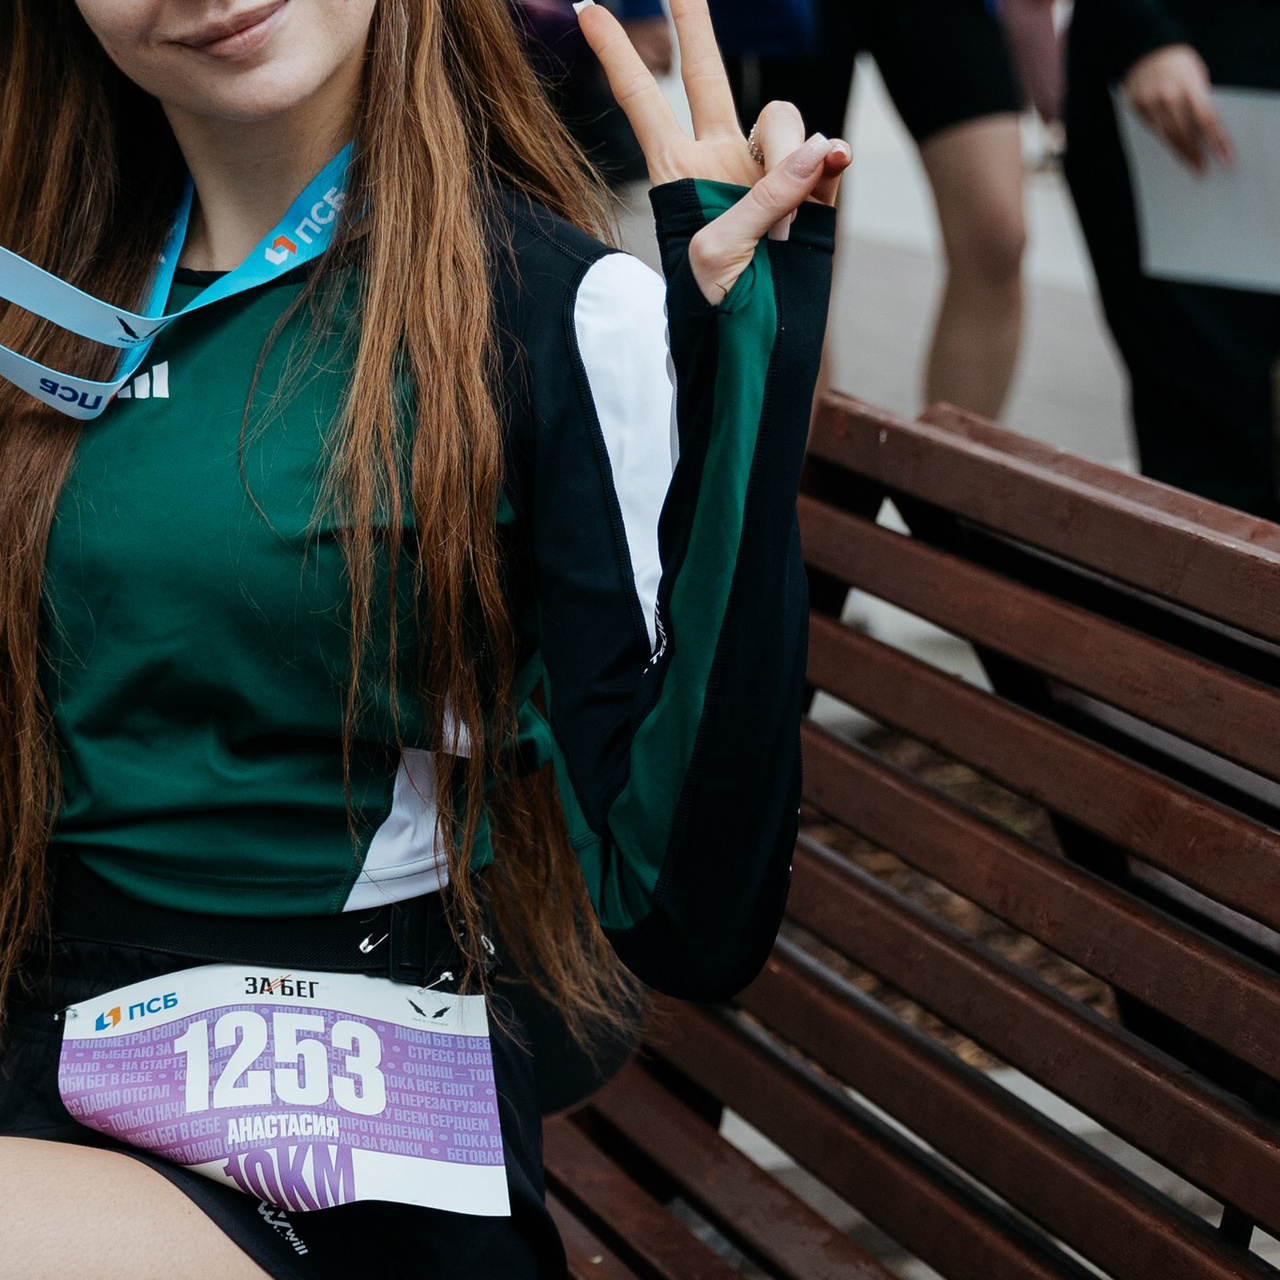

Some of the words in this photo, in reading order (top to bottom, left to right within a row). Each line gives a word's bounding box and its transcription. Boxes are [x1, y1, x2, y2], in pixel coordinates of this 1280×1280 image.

[40, 378, 103, 410] ПСБ
[129, 992, 179, 1021] ПСБ
[72, 1031, 151, 1049] КИЛОМЕТРЫ
[395, 1025, 432, 1046] ЛЮБИ
[432, 1032, 455, 1048] БЕГ
[456, 1036, 466, 1049] В
[92, 1046, 154, 1060] ВЫБЕГАЮ
[155, 1042, 172, 1056] ЗА
[407, 1044, 455, 1064] СТРЕСС
[121, 1061, 138, 1071] НА
[140, 1055, 187, 1070] СТАРТЕ
[173, 1010, 387, 1116] 1253
[402, 1061, 454, 1080] ФИНИШ
[86, 1073, 109, 1090] БЕГ
[110, 1072, 120, 1086] В
[121, 1070, 153, 1085] СЕБЕ
[416, 1078, 441, 1094] ВСЕ
[441, 1080, 475, 1097] СПЯТ
[81, 1088, 122, 1117] ДАВНО
[122, 1083, 170, 1105] ОТСТАЛ
[400, 1092, 495, 1115] ПЕРЕЗАГРУЗКА
[107, 1104, 155, 1132] ТОЛЬКО
[180, 1120, 190, 1141] В
[190, 1116, 221, 1139] СЕБЕ
[228, 1114, 340, 1145] АНАСТАСИЯ
[393, 1108, 429, 1126] ВСЕМ
[429, 1113, 490, 1132] СЕРДЦЕМ
[361, 1134, 379, 1150] ЗА
[379, 1138, 423, 1157] РАМКИ
[453, 1132, 489, 1148] ПОКА
[446, 1147, 504, 1165] БЕГОВАЯ
